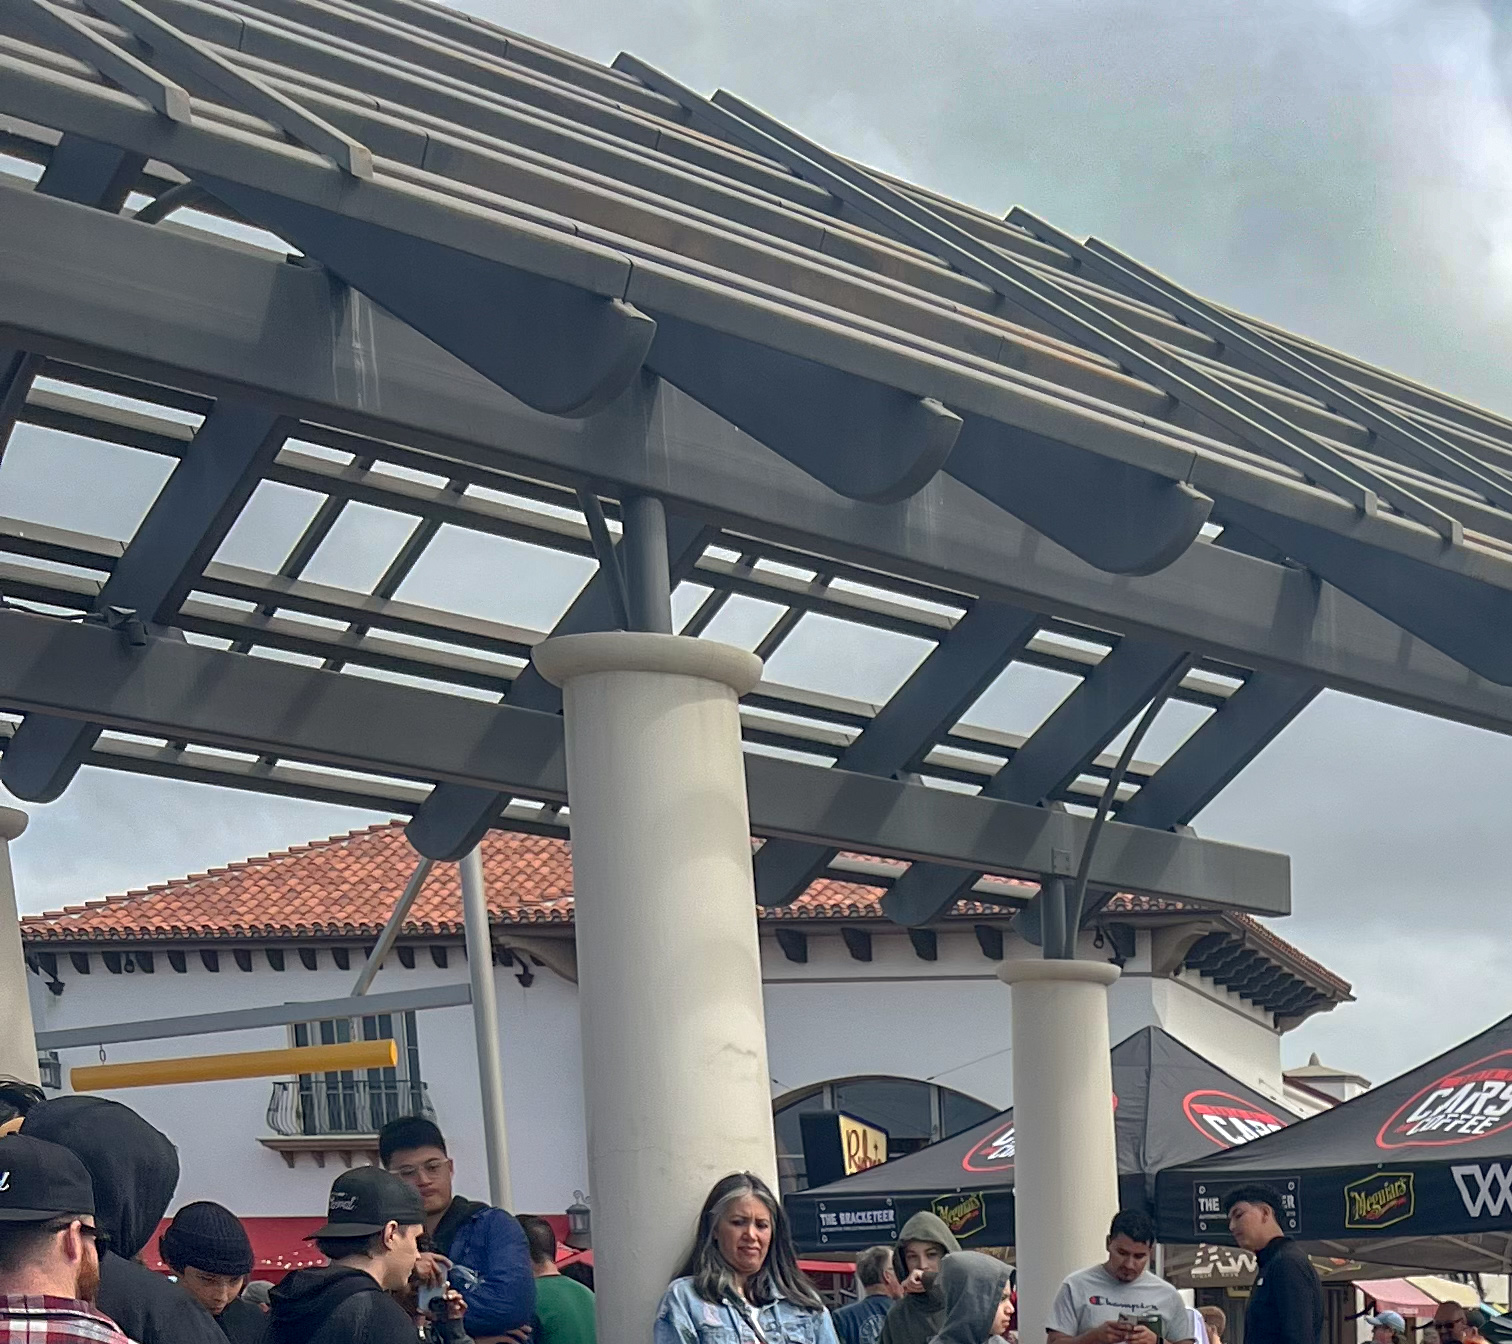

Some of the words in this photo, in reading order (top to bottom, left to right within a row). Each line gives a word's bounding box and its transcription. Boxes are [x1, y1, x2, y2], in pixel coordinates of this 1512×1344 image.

[1406, 1114, 1500, 1136] COFFEE
[1198, 1197, 1220, 1212] THE
[819, 1212, 838, 1226] THE
[1089, 1296, 1158, 1312] Champion
